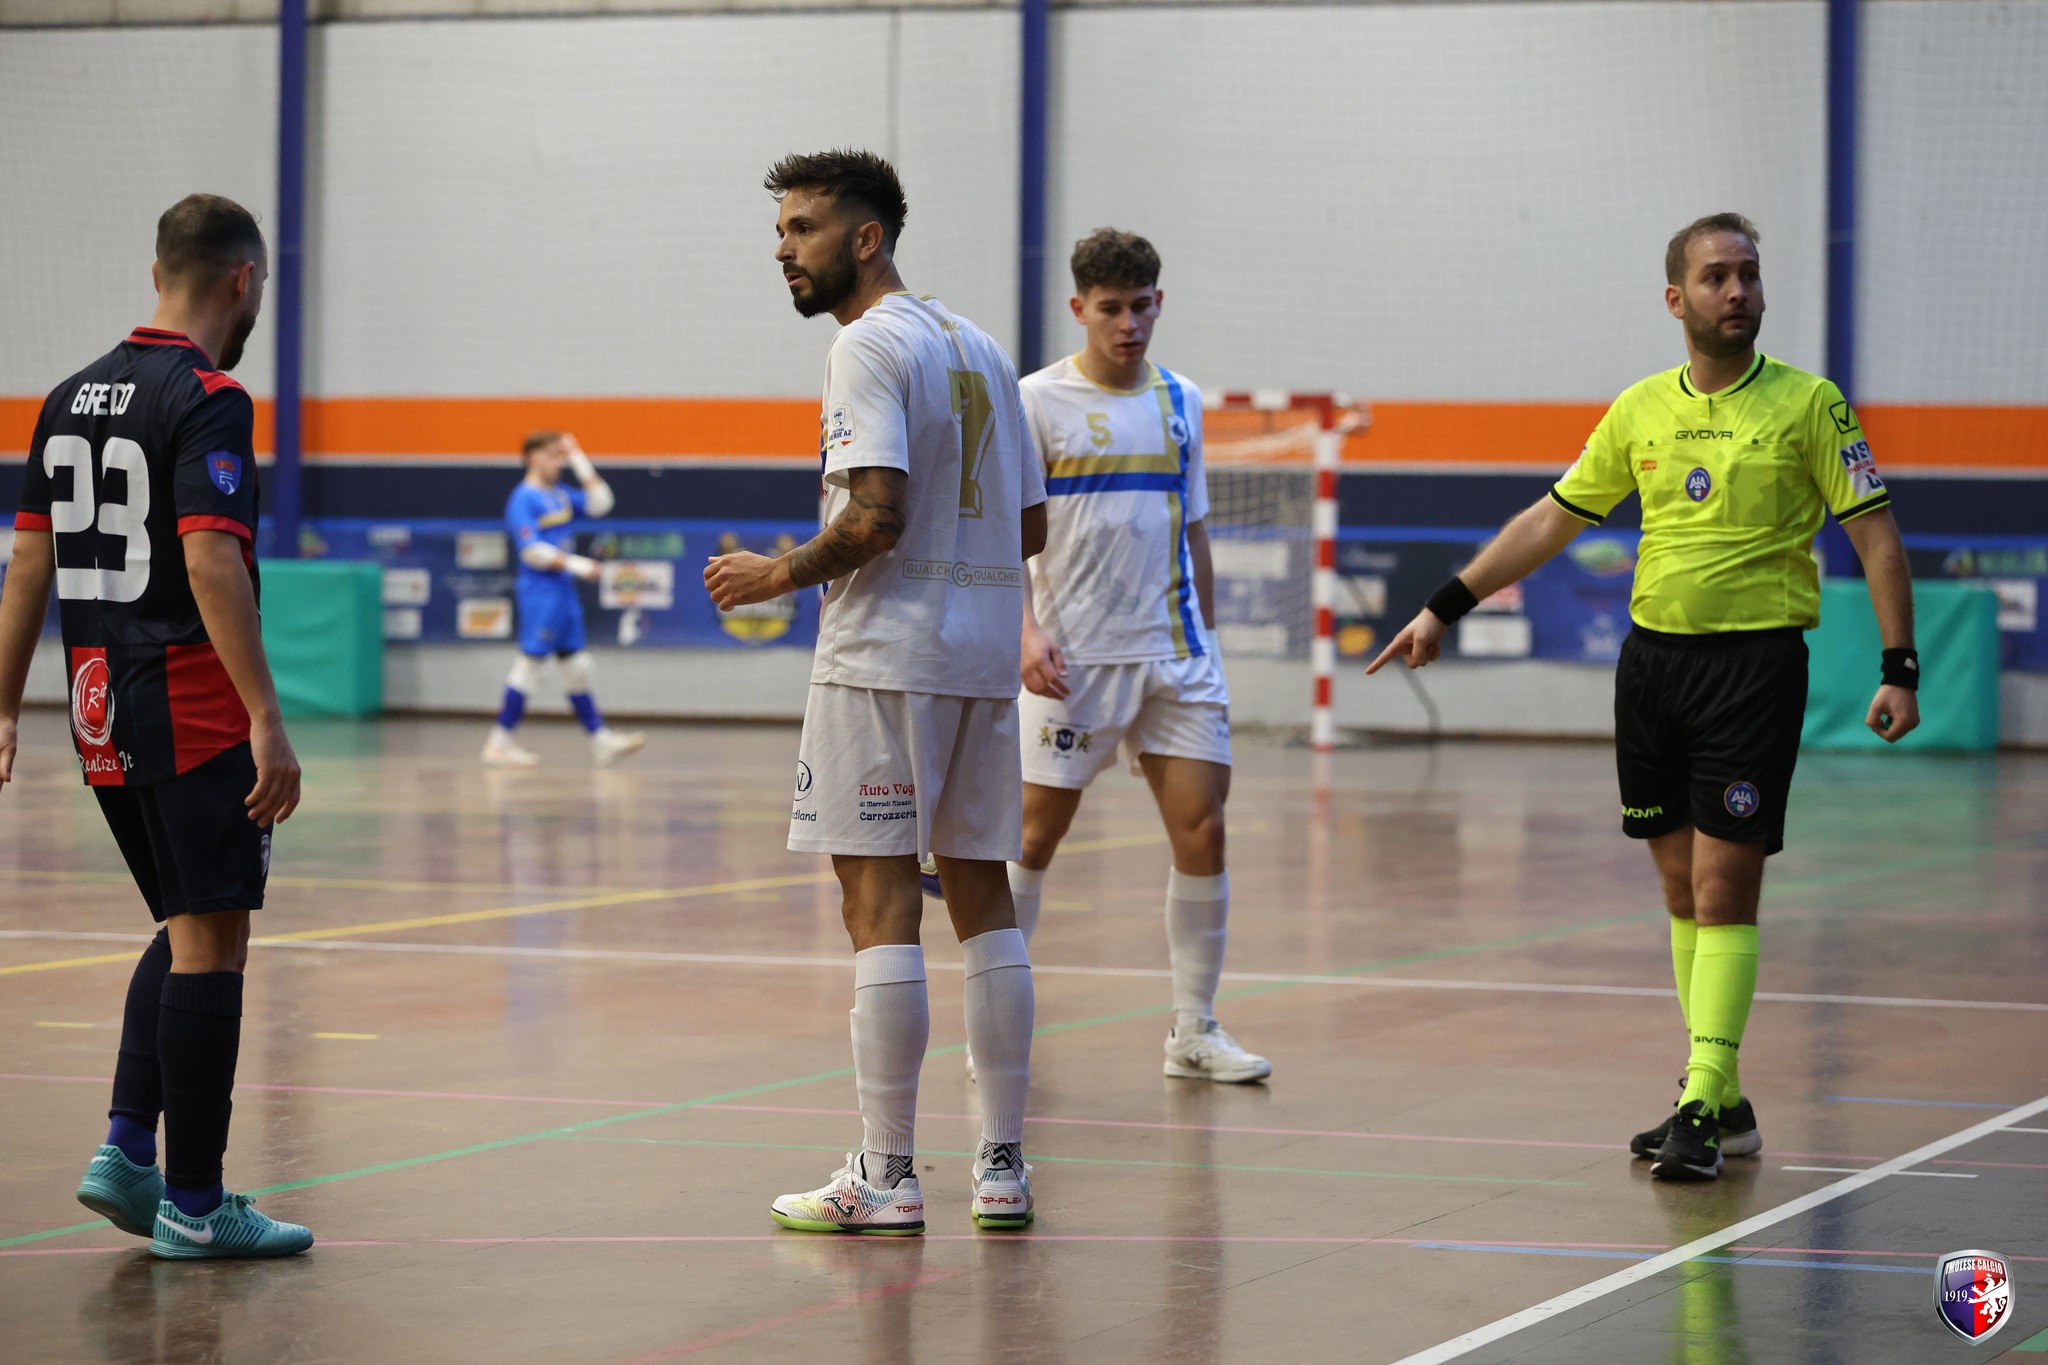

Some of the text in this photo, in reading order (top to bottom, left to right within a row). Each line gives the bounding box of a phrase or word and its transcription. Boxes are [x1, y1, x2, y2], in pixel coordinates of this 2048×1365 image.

[71, 383, 136, 416] GRECO
[843, 429, 852, 437] A2
[1086, 412, 1112, 448] 5
[1675, 430, 1733, 440] GIVOVA
[1688, 475, 1708, 490] AIA
[43, 435, 151, 603] 23
[859, 784, 890, 796] Auto
[1731, 790, 1753, 806] AIA
[859, 809, 917, 821] Carrozzeria
